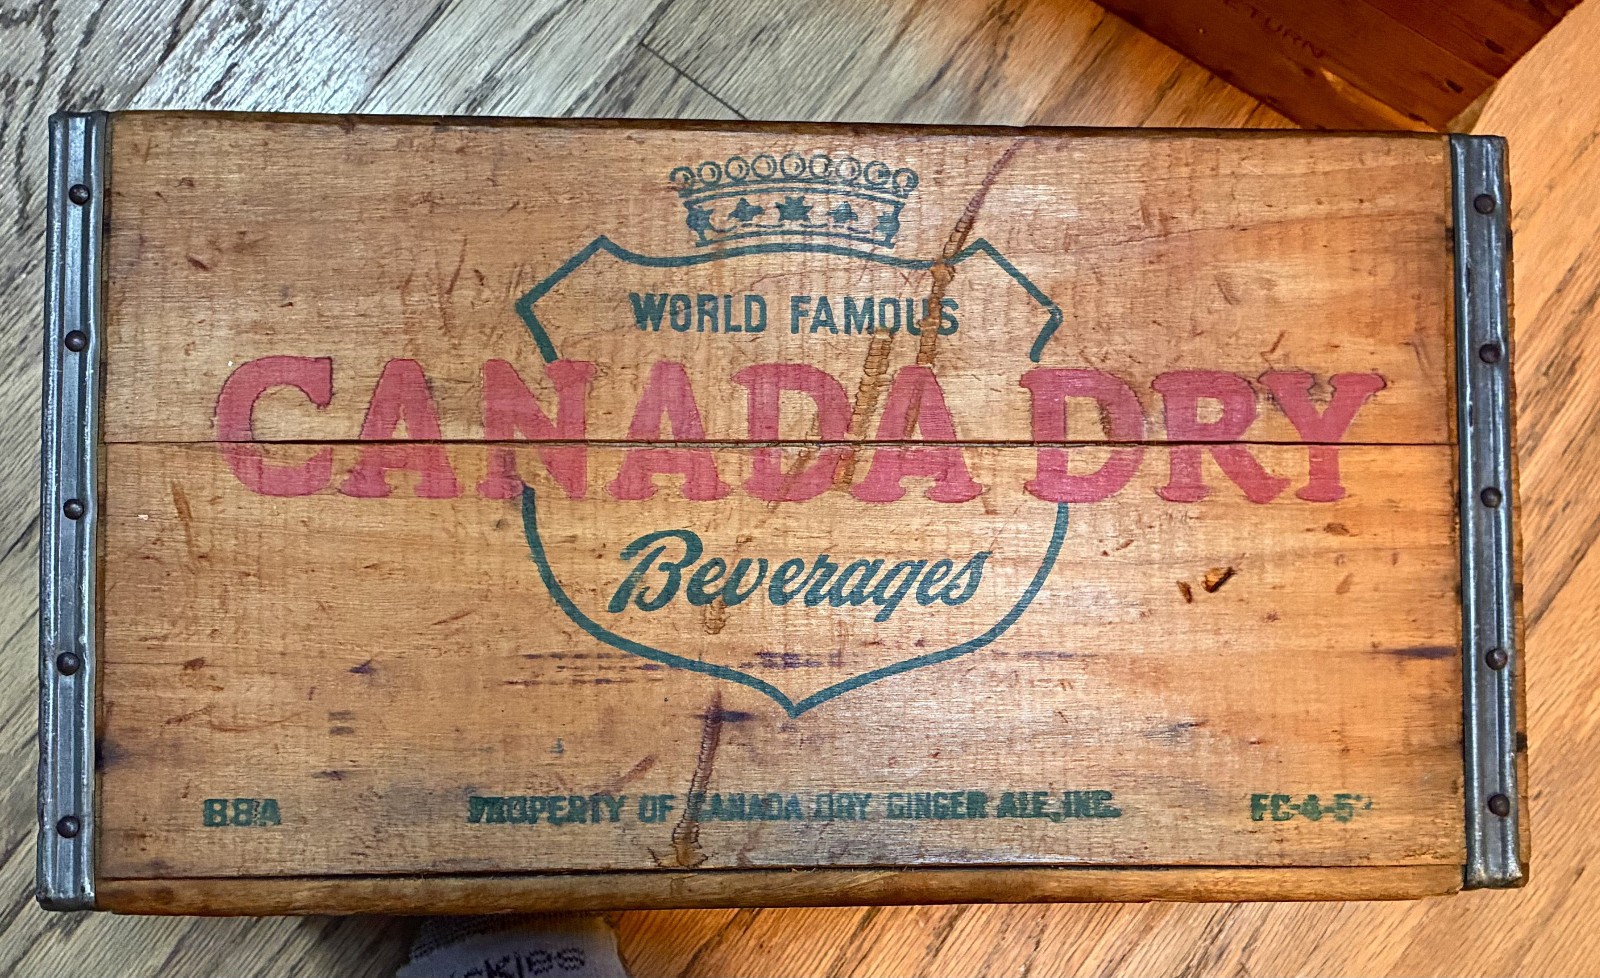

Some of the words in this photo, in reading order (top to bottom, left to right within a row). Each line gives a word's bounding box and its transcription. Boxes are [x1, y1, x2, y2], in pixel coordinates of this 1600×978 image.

[628, 292, 768, 333] WORLD
[789, 296, 960, 336] FAMOUS
[213, 355, 983, 503] CANADA
[1020, 367, 1386, 504] DRY
[607, 529, 993, 622] Beverages
[467, 795, 626, 825] PROPERTY
[638, 795, 675, 823] OF
[814, 793, 872, 821] DRY
[886, 791, 987, 820] GINGER
